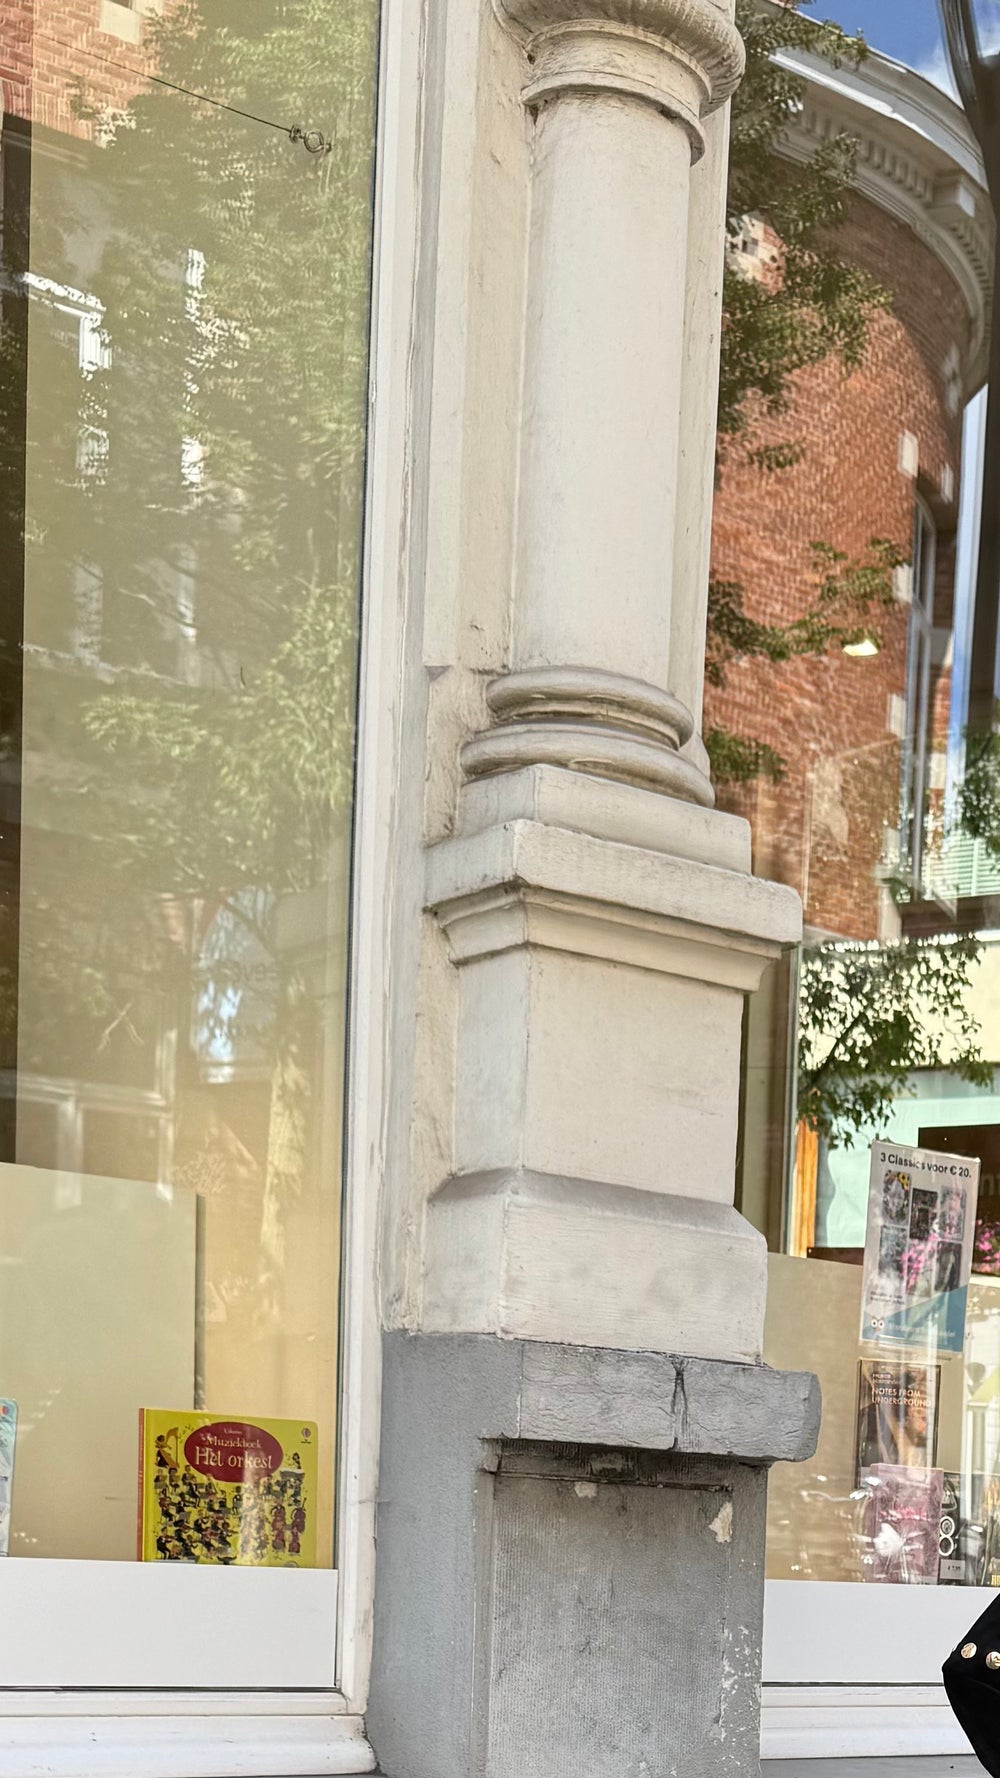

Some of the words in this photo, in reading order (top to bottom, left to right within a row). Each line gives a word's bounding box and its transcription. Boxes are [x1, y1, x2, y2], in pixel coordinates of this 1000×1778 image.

[880, 1152, 887, 1162] 3
[927, 1163, 948, 1174] voor
[949, 1165, 957, 1175] €
[872, 1387, 897, 1396] NOTES
